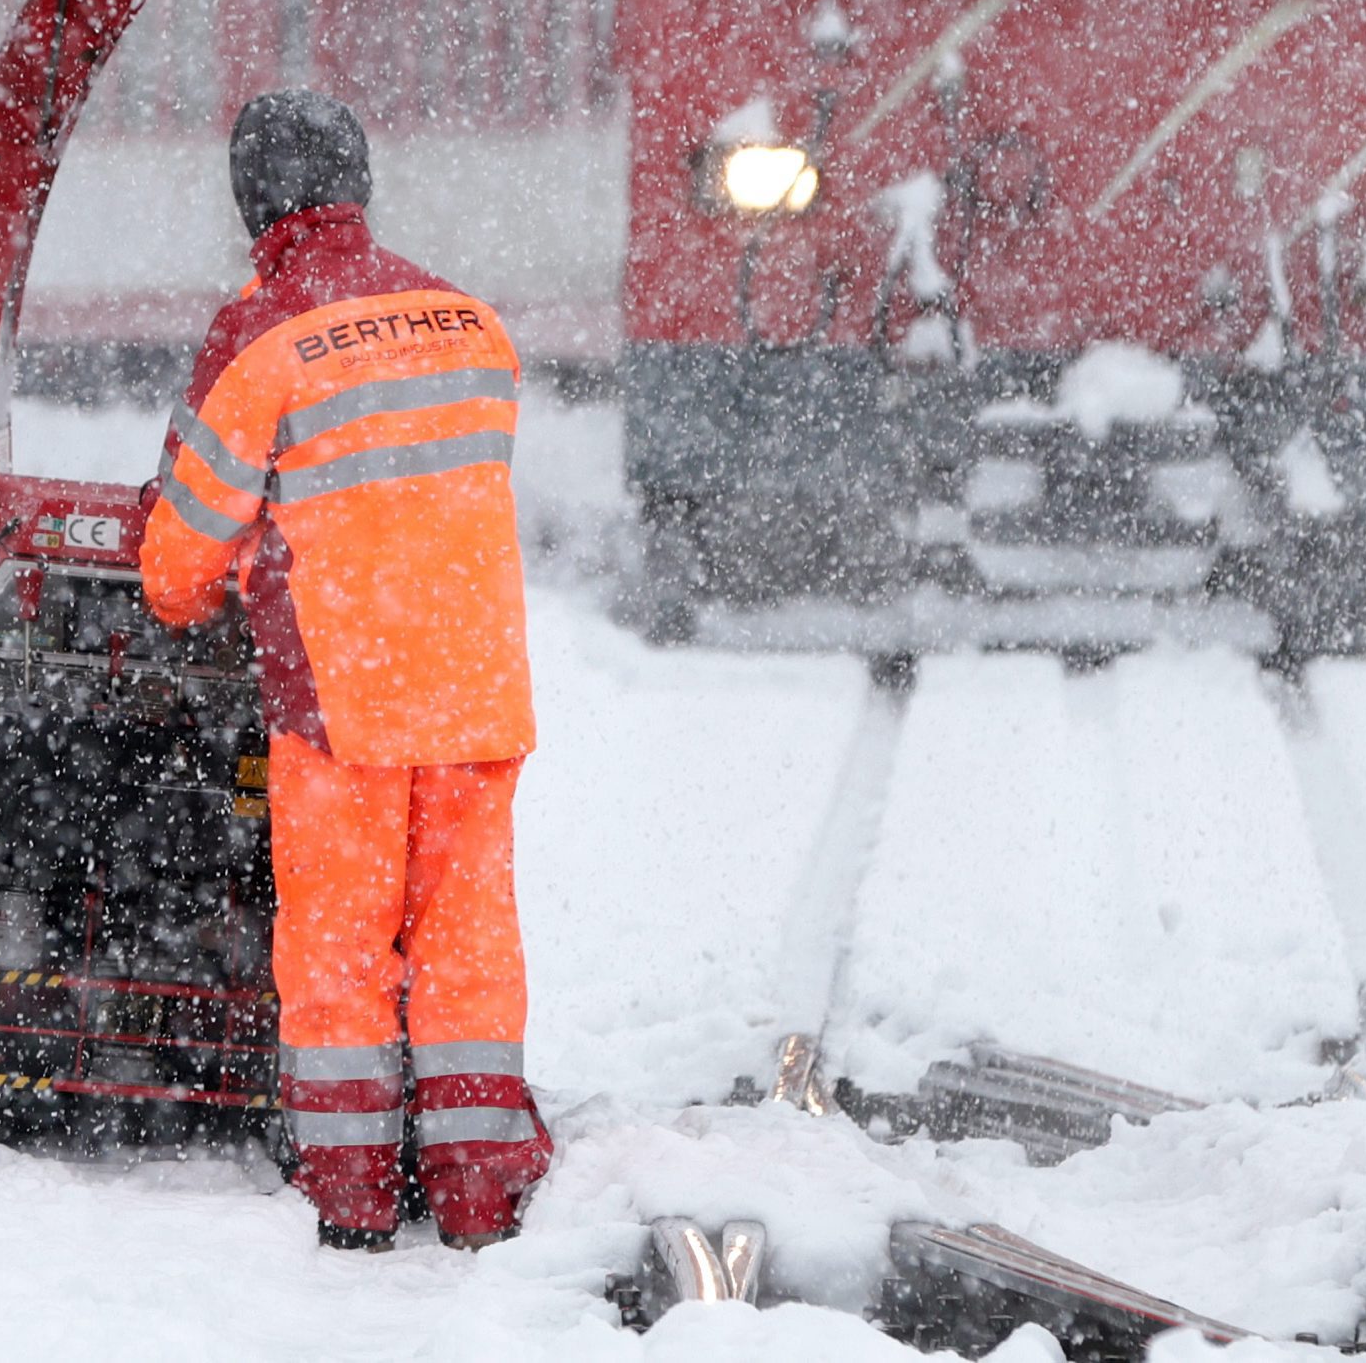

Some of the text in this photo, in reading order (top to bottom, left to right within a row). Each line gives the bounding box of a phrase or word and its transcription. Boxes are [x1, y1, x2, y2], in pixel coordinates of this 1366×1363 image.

[294, 309, 485, 363] BERTHER
[340, 351, 370, 369] BAU
[372, 348, 398, 361] UD
[68, 518, 107, 547] CE
